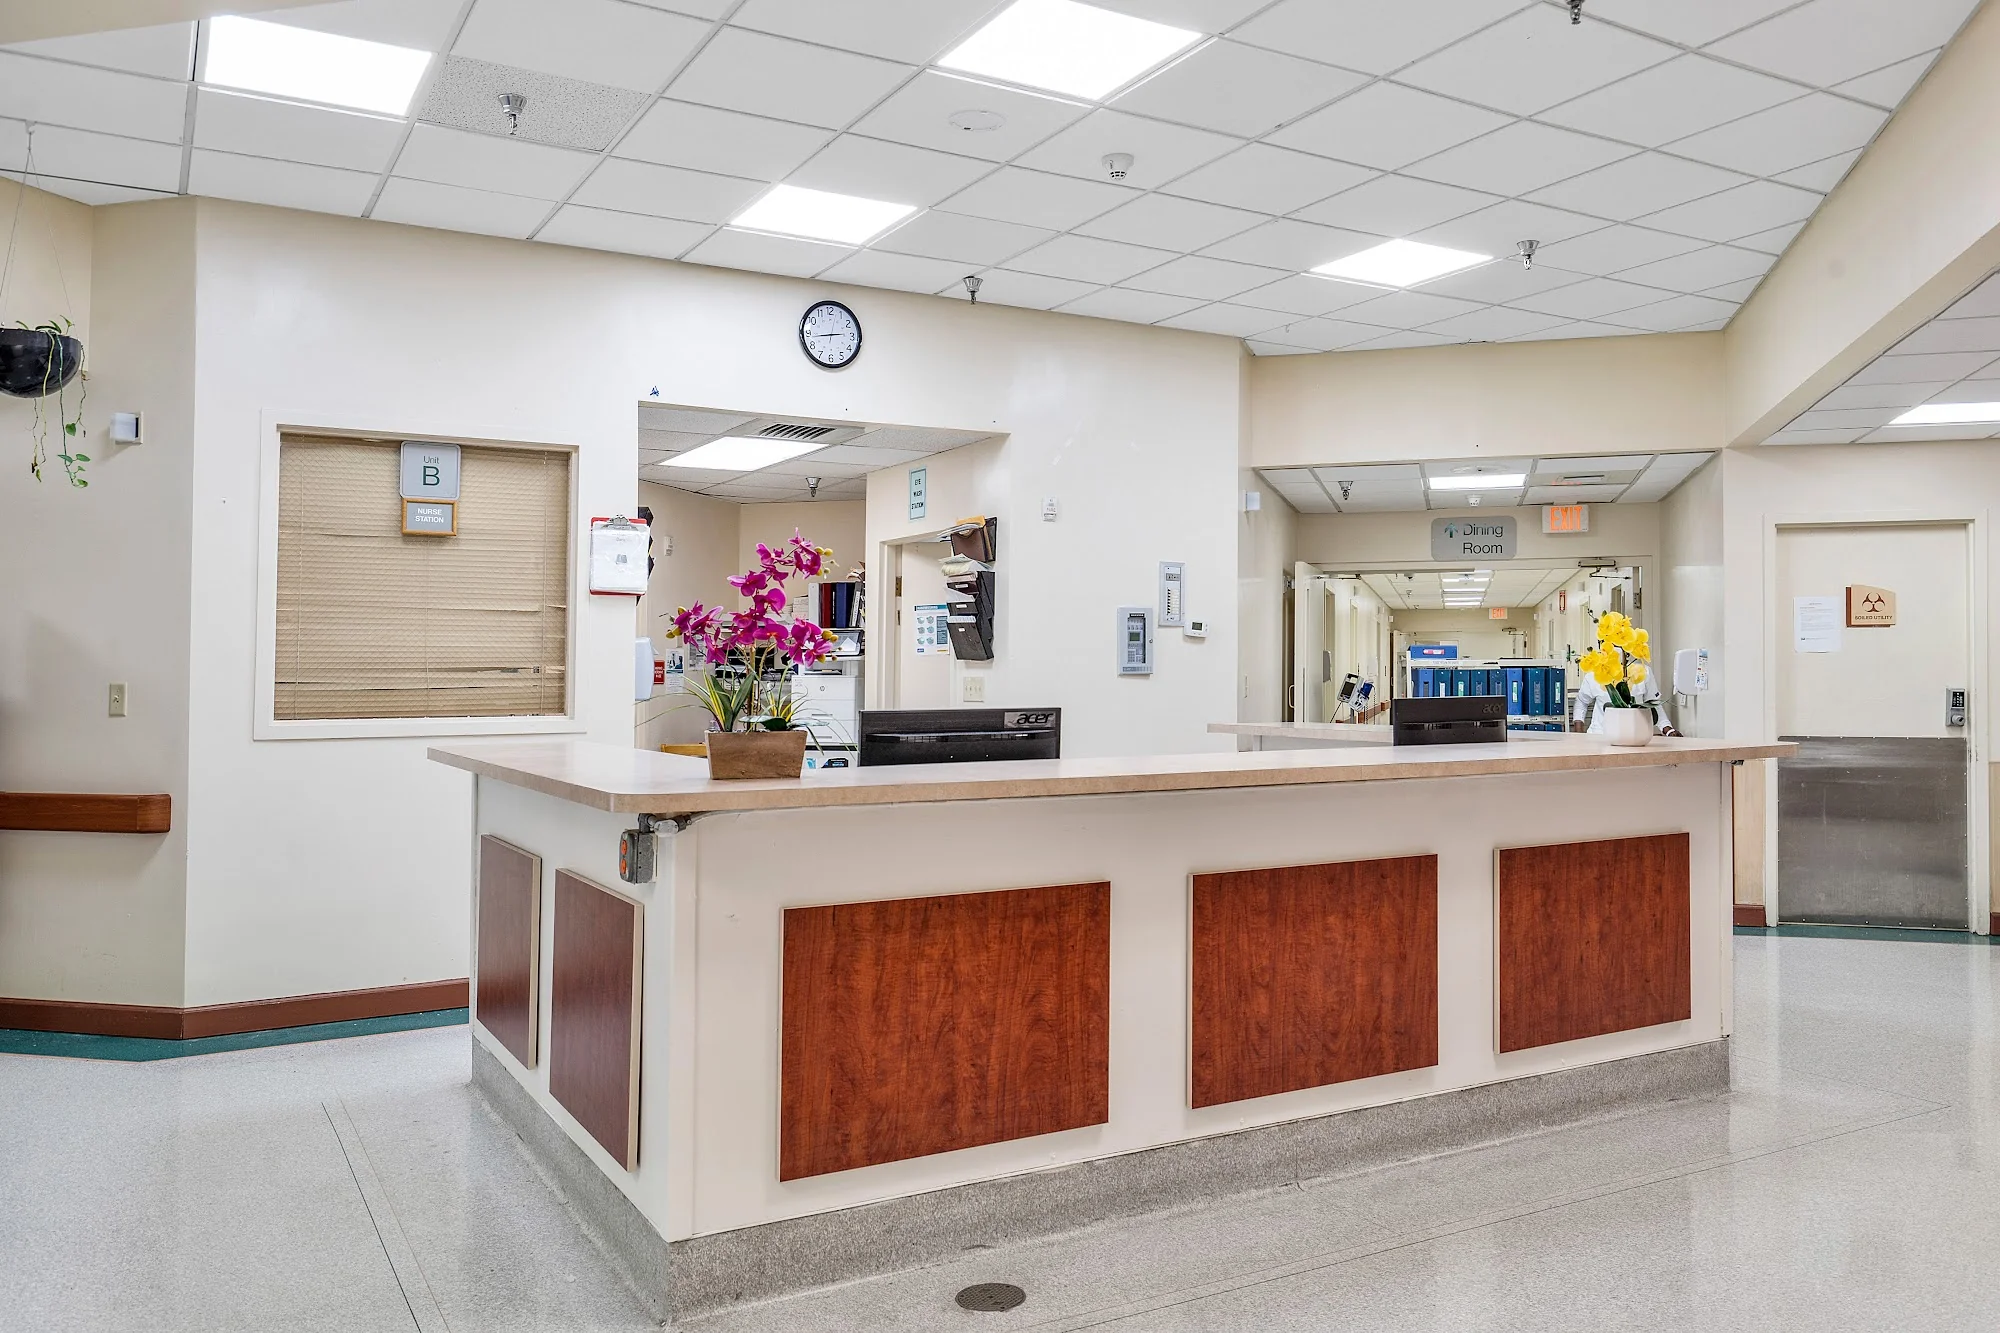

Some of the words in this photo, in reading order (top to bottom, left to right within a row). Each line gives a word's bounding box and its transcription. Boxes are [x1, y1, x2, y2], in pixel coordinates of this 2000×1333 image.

[817, 309, 823, 317] 11
[826, 306, 834, 315] 12
[808, 316, 816, 325] 10
[423, 455, 440, 464] Unit
[422, 465, 440, 486] B
[417, 507, 442, 516] NURSE
[415, 515, 444, 523] STATION
[1550, 506, 1582, 530] EXIT
[1463, 523, 1504, 538] Dining
[1463, 542, 1503, 554] Room
[1482, 703, 1504, 714] acer
[1016, 712, 1054, 725] acer
